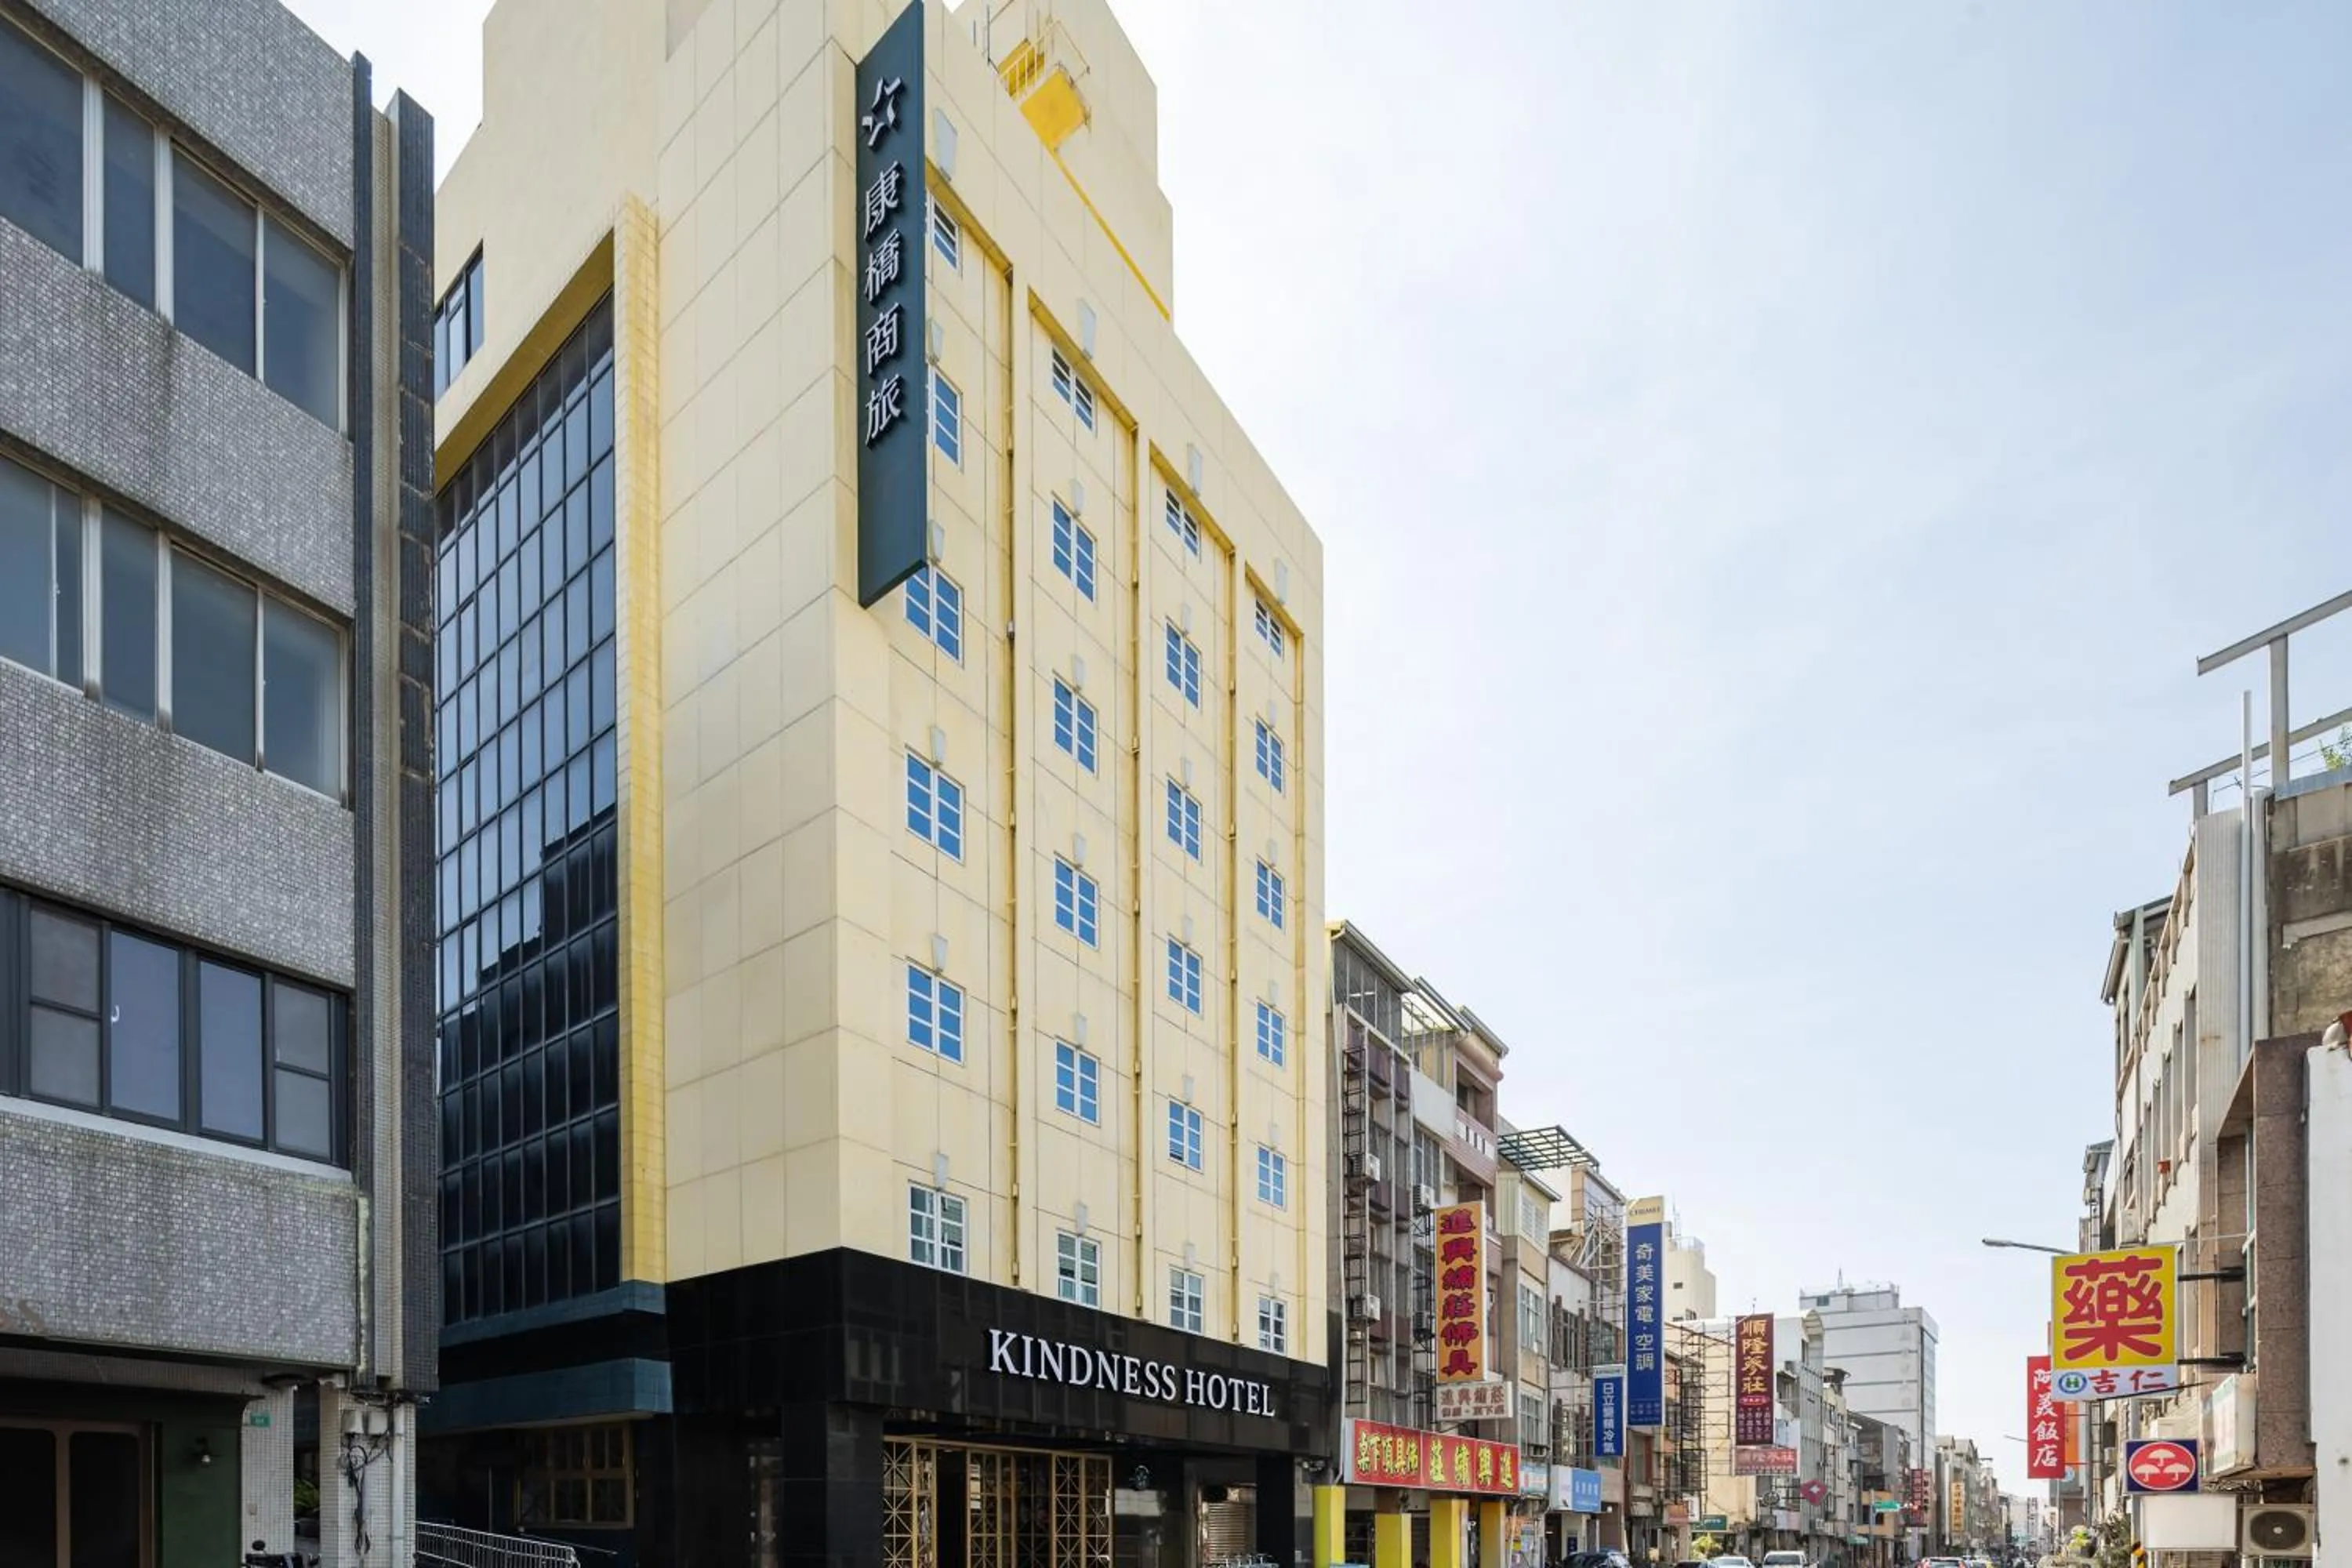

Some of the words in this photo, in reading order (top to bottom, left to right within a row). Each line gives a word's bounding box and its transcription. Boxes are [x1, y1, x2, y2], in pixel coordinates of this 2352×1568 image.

[864, 160, 901, 446] 康橋商旅
[2063, 1255, 2163, 1362] 藥
[988, 1328, 1176, 1402] KINDNESS
[1185, 1368, 1276, 1417] HOTEL
